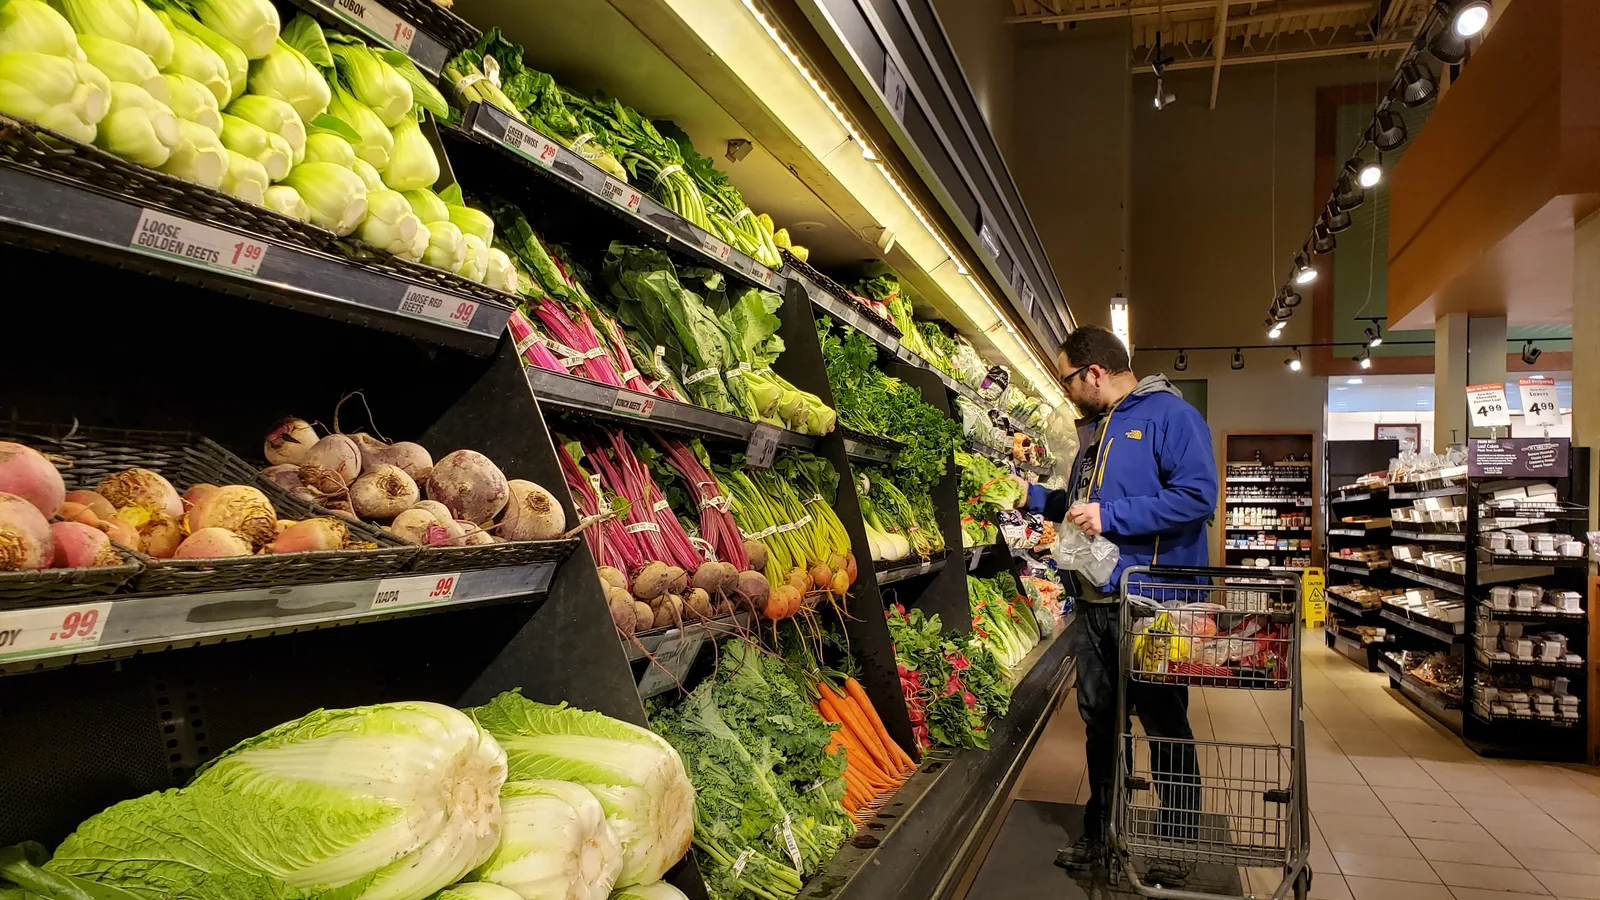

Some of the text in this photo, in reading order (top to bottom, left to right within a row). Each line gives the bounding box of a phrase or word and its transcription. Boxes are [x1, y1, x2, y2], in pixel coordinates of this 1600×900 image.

[504, 134, 522, 149] CHARD
[507, 125, 539, 149] GREEN SWISS
[601, 188, 615, 200] CHARD
[604, 180, 624, 197] RED SWISS
[141, 218, 182, 239] LOOSE
[137, 232, 220, 263] GOLDEN BEETS
[401, 301, 424, 314] BEETS
[406, 291, 443, 309] LOOSE RED
[615, 398, 642, 411] BUNCH BEETS
[375, 590, 399, 604] NAPA
